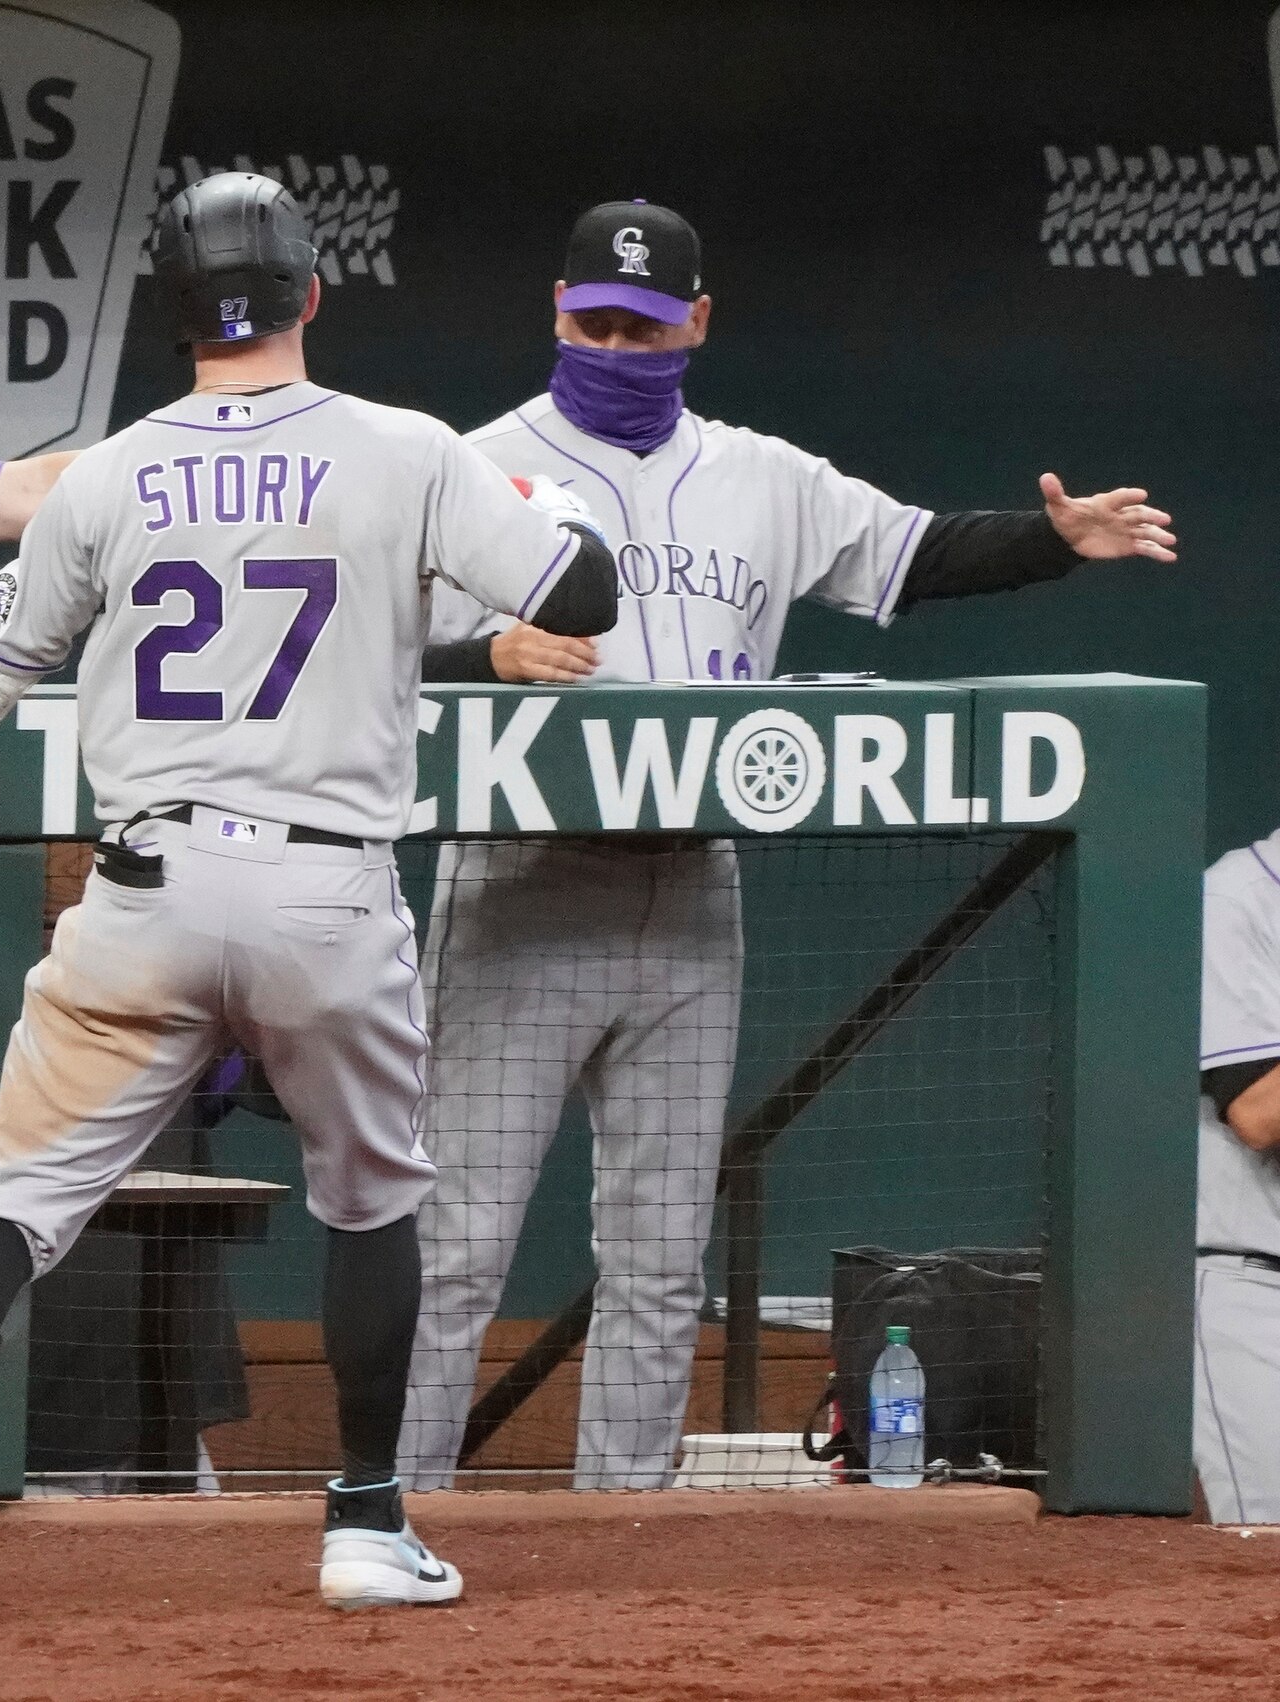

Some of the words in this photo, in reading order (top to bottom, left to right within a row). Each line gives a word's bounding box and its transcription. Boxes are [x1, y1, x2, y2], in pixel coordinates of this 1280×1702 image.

[219, 296, 249, 321] 27
[135, 452, 335, 534] STORY
[129, 556, 339, 723] 27
[580, 708, 1086, 833] WORLD
